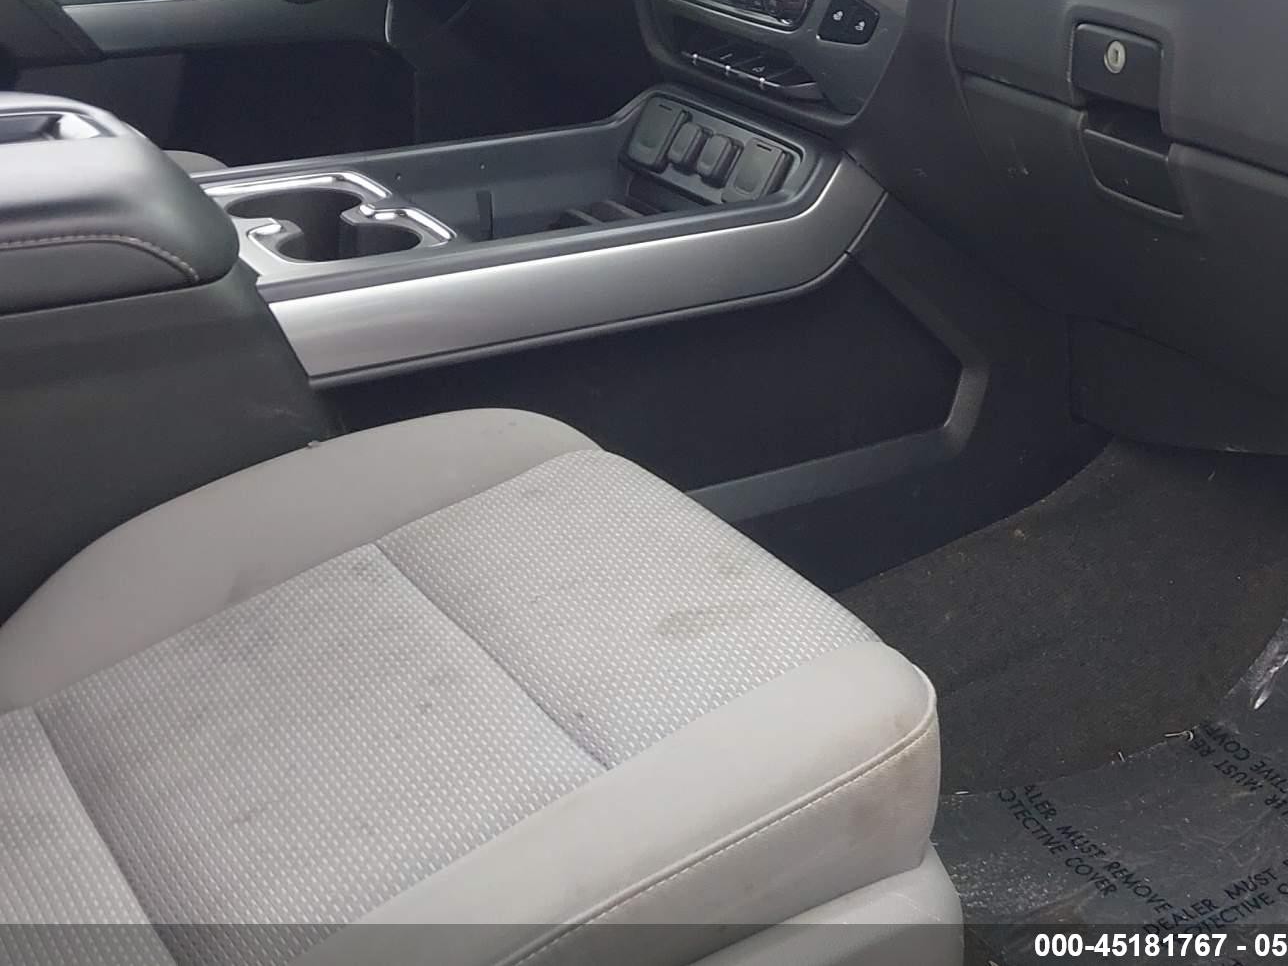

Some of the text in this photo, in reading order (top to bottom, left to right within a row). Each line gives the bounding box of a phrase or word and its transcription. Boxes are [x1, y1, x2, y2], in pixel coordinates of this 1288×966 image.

[1056, 825, 1106, 859] MUST
[1104, 861, 1173, 914] REMOVE
[1065, 857, 1118, 897] COVER
[1224, 868, 1278, 902] MUST
